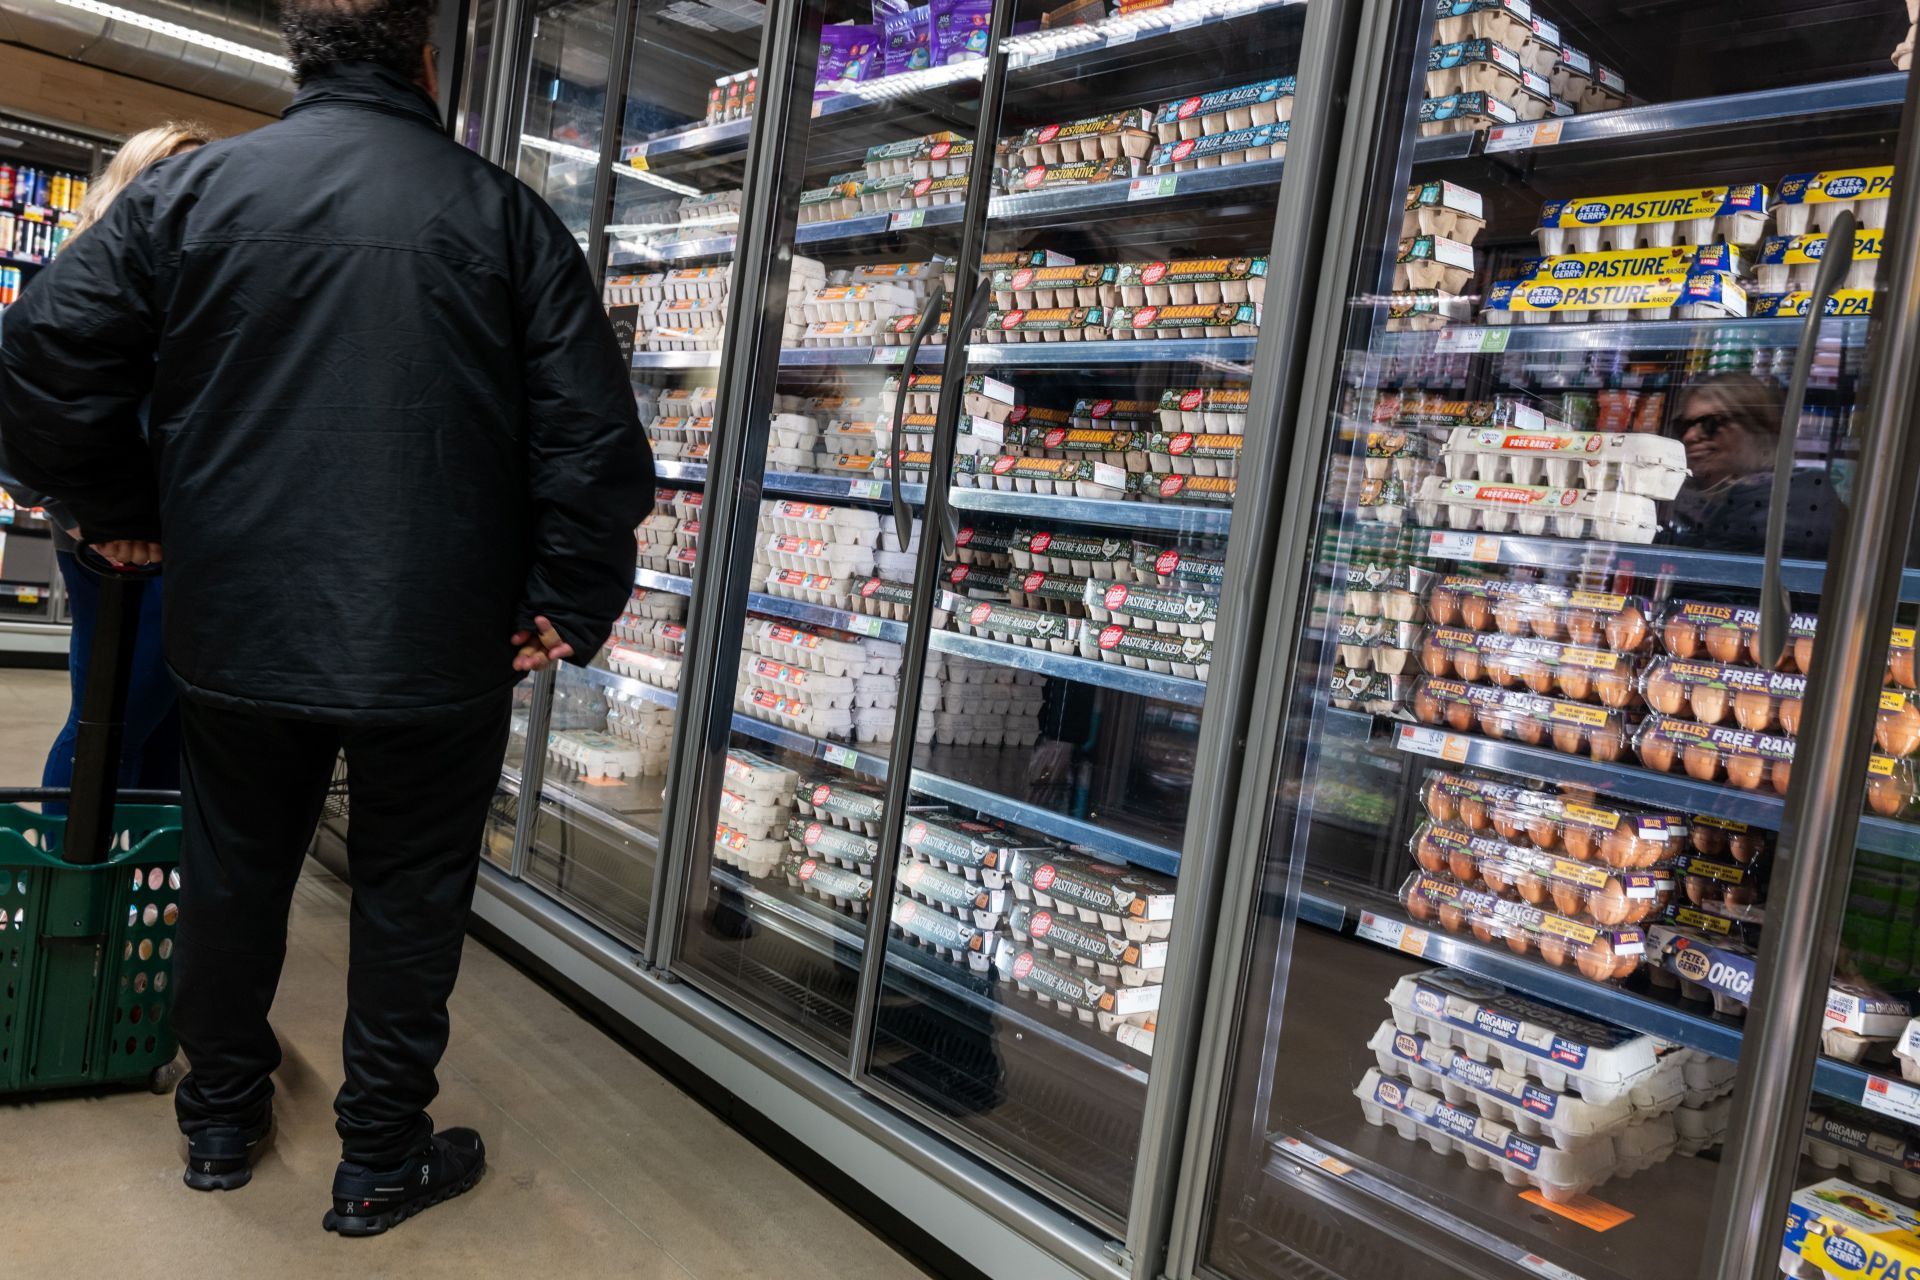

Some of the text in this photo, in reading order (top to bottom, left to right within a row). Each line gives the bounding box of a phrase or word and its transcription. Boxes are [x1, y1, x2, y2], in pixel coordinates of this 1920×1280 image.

[1201, 87, 1261, 108] TRUE BLUES
[1058, 120, 1108, 136] RESTORATIVE
[1194, 132, 1254, 150] TRUE BLUES
[1045, 168, 1095, 180] RESTORATIVE
[1577, 211, 1608, 220] GERRY's
[1610, 197, 1699, 220] PASTURE
[982, 252, 1016, 264] RGANIC
[1170, 260, 1229, 274] ORGANIC
[1585, 256, 1670, 278] PASTURE
[1036, 266, 1084, 280] ORGANIC
[1563, 285, 1654, 305] PASTURE
[1025, 308, 1072, 322] ORGANIC
[1160, 304, 1215, 318] ORGANIC
[1068, 430, 1114, 442] ORGANIC
[1510, 438, 1556, 450] FREE RANGE
[1016, 458, 1063, 470] ORGANIC
[1186, 478, 1236, 492] ORGANIC
[1483, 490, 1530, 502] FREE RANGE
[1048, 540, 1102, 554] PASTURE-RAISED
[1484, 580, 1517, 593] FREE
[1124, 596, 1184, 614] PASTURE-RAISED
[988, 612, 1036, 630] PASTURE-RAISED
[1734, 609, 1760, 625] FRE
[1120, 635, 1182, 655] PASTURE-RAISED
[1476, 635, 1509, 649] FREE
[1722, 669, 1764, 686] FREE
[1770, 674, 1807, 692] RAN
[1468, 687, 1500, 702] FREE
[1503, 692, 1552, 712] RANGE
[1712, 730, 1754, 747] FREE
[1759, 737, 1796, 754] RAN
[1481, 784, 1512, 801] FREE
[1470, 838, 1503, 855] FREE
[1052, 877, 1111, 906] PASTURE-RAISED
[1460, 890, 1493, 908] FREE
[1494, 897, 1542, 924] RANGE
[1048, 924, 1106, 955] PASTURE-RAISED
[1028, 966, 1082, 999] PASTURE-RAISED
[1477, 1011, 1518, 1033] ORGANIC
[1479, 1023, 1510, 1039] FREE RANGE
[1453, 1056, 1492, 1077] ORGANIC
[1436, 1104, 1474, 1129] ORGANIC
[1438, 1116, 1467, 1134] FREE RANGE
[1825, 1121, 1867, 1144] ORGANIC
[1826, 1245, 1864, 1268] GERRY's
